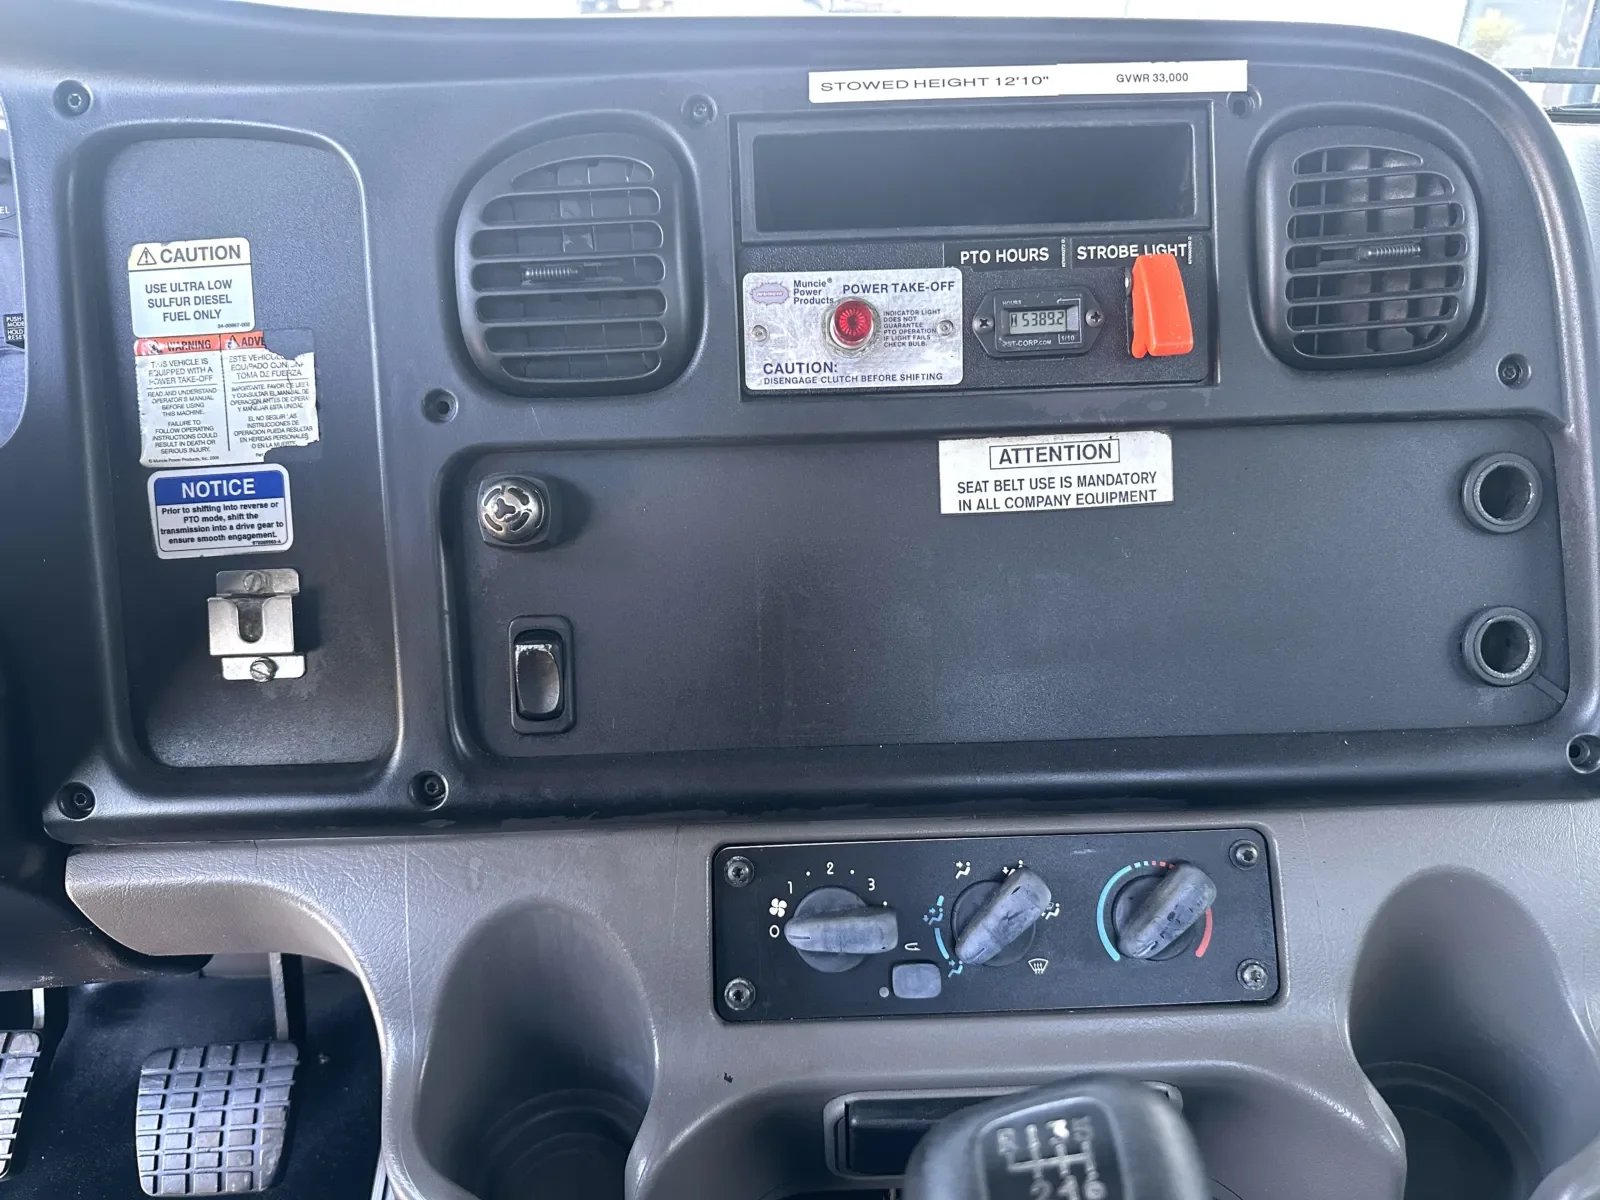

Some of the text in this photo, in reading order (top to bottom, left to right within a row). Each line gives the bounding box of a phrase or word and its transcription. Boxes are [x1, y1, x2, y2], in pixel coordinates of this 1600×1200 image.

[820, 76, 1049, 92] STOWED HEIGHT 12'10"
[1116, 72, 1189, 83] GVWR 33,000
[160, 245, 241, 263] CAUTION
[960, 250, 991, 264] PTO
[996, 248, 1049, 262] HOURS
[1076, 245, 1139, 260] STROBE
[1145, 244, 1187, 257] LIGHT
[145, 280, 232, 293] USE ULTRA LOW
[843, 281, 955, 294] POWER TAKE-OFF
[148, 294, 232, 308] SULFUR DIESEL
[163, 309, 222, 322] FUEL ONLY
[229, 354, 246, 363] ESTE
[149, 368, 185, 377] EQUIPPED
[763, 361, 837, 375] CAUTION:
[764, 373, 943, 385] DISENGAGE CLUTCH BEFORE SHIFTING
[999, 442, 1112, 464] ATTENTION
[182, 478, 256, 499] NOTICE
[957, 472, 1157, 494] SEAT BELT USE IS MANDATORY
[959, 490, 1157, 512] IN ALL COMPANY EQUIPMENT
[161, 506, 180, 515] Prior
[192, 504, 221, 514] shifting
[223, 503, 238, 511] into
[202, 514, 226, 523] mode,
[160, 524, 210, 535] transmission
[212, 523, 227, 532] into
[236, 521, 255, 530] drive
[258, 522, 274, 530] gear
[169, 532, 277, 544] ensure smooth engagement.
[826, 862, 834, 875] 2
[788, 881, 793, 894] 1
[868, 878, 875, 891] 3
